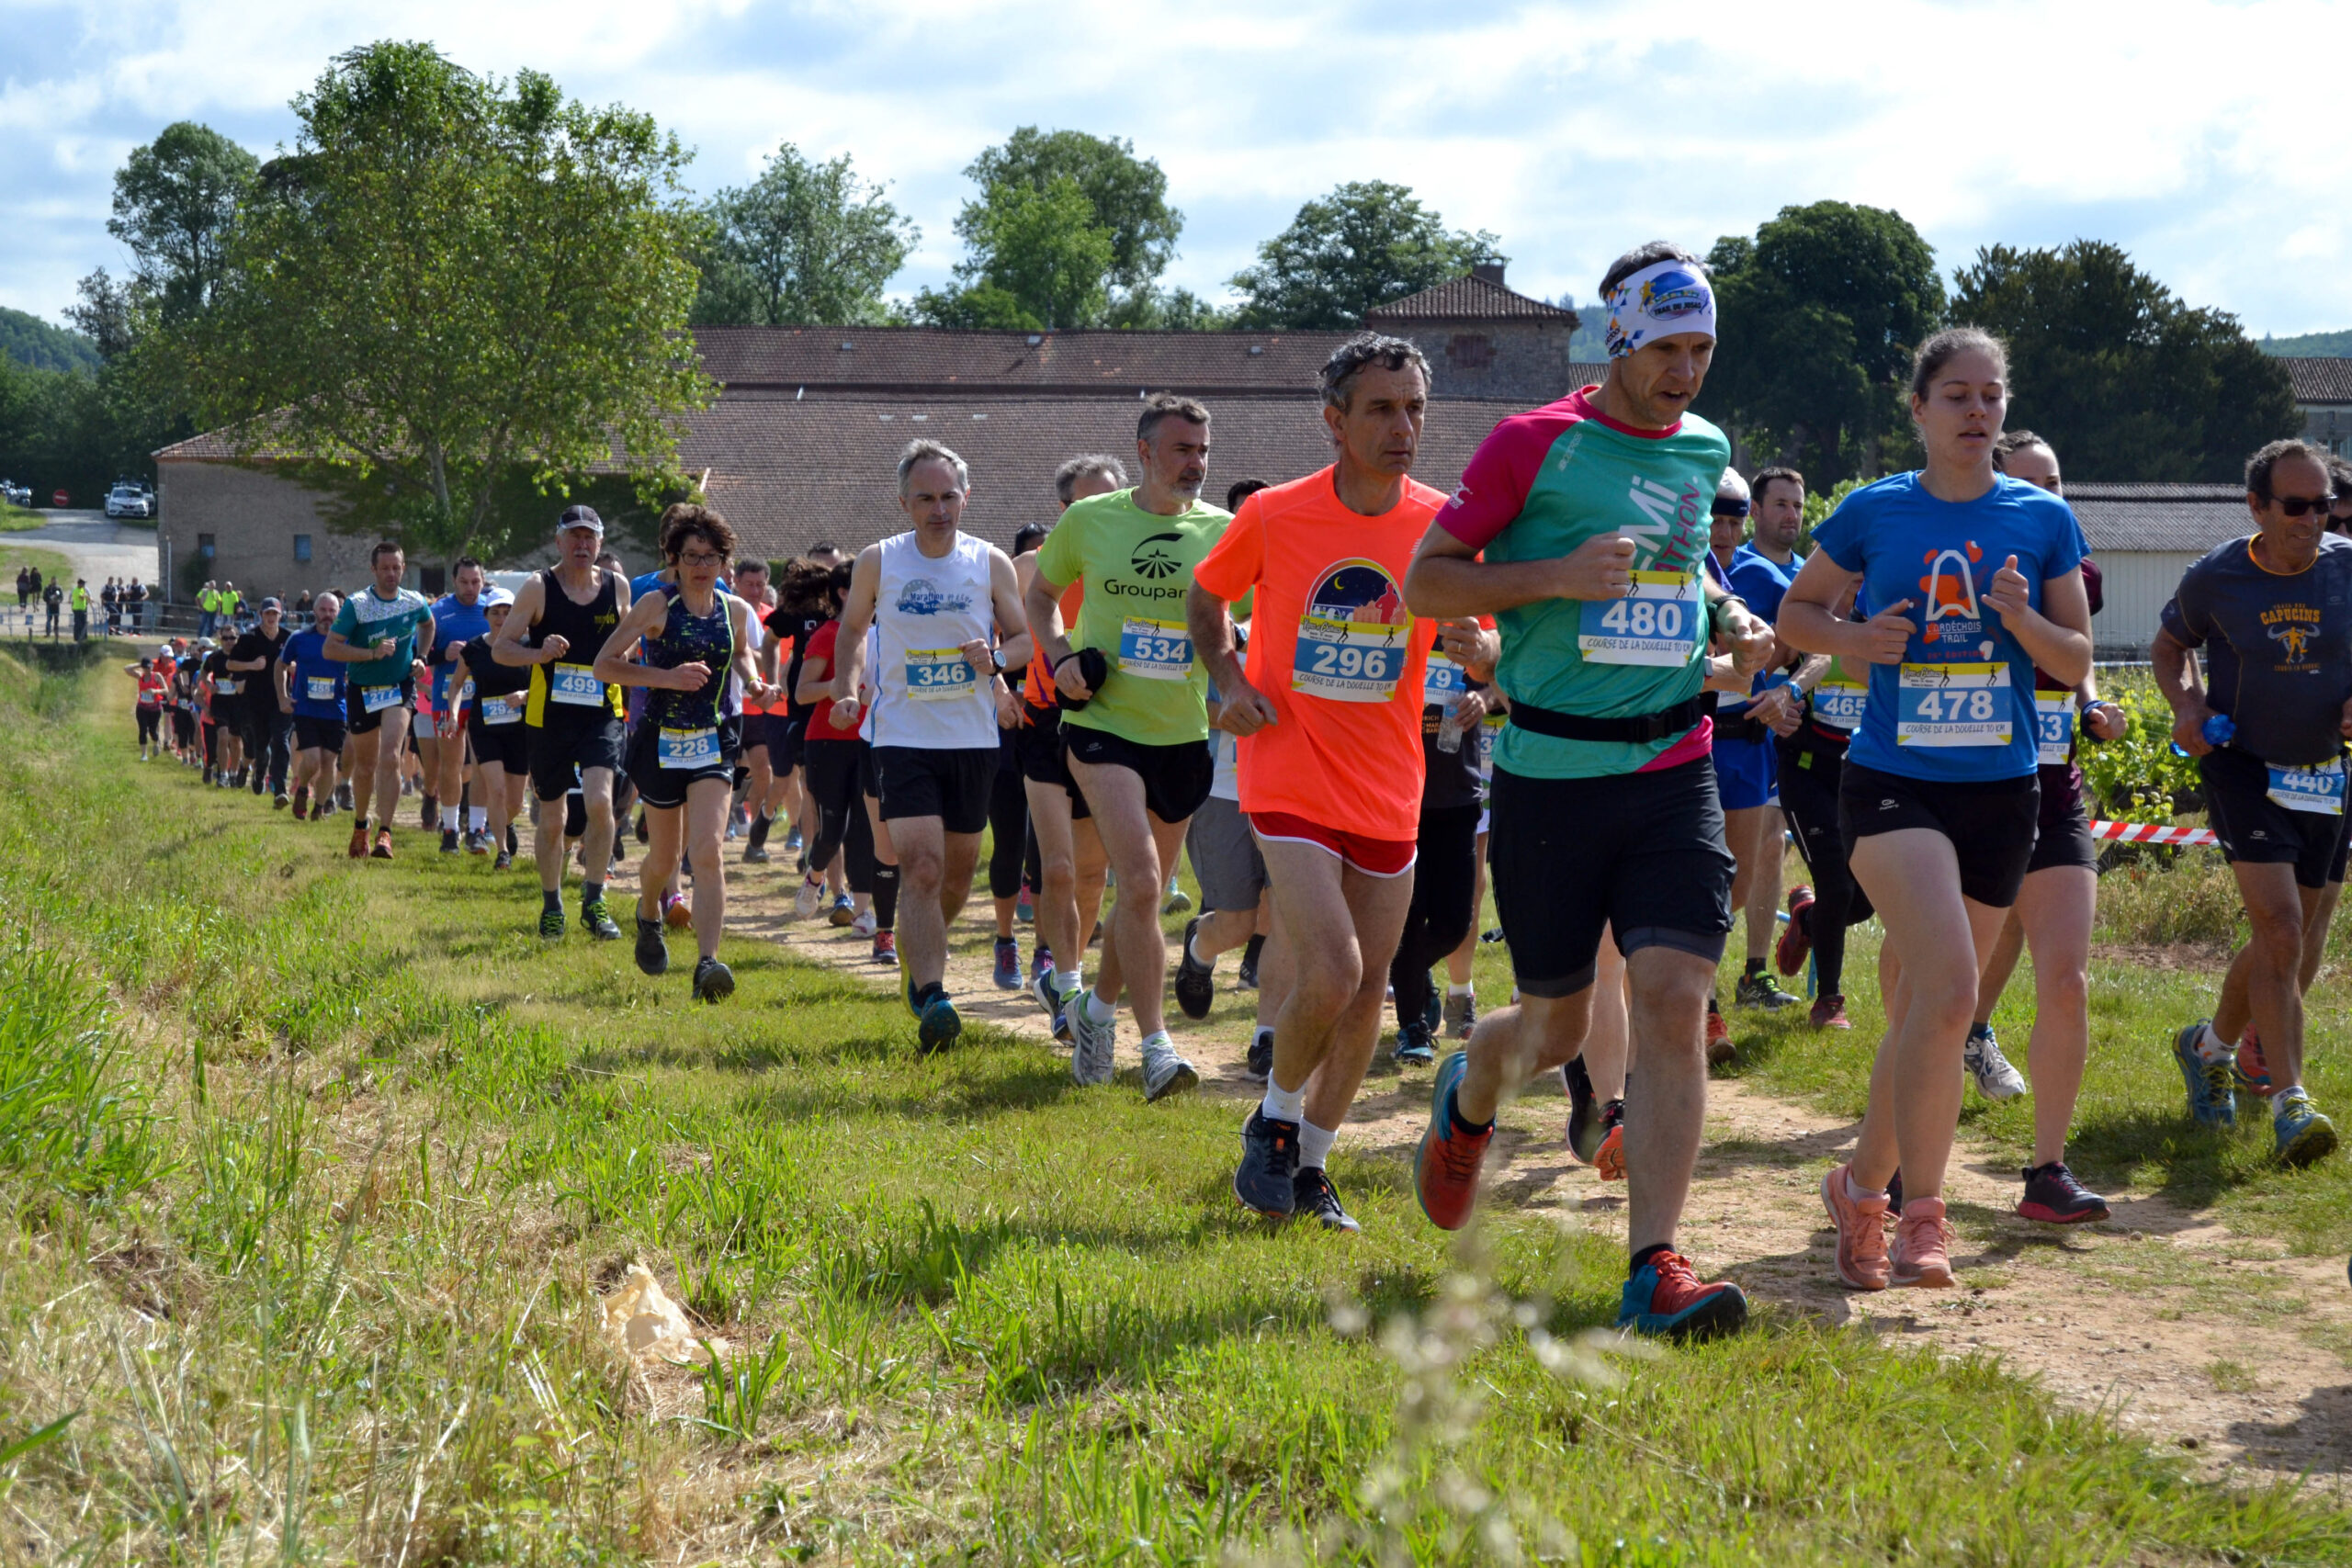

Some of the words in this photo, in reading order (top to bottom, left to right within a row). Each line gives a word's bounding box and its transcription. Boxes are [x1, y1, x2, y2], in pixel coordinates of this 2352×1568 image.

[1601, 600, 1682, 637] 480
[2260, 608, 2320, 625] CAPUCINS
[1587, 637, 1617, 649] COURSE
[1619, 639, 1629, 649] DE
[1631, 640, 1640, 650] LA
[1642, 641, 1672, 651] DOUELLE
[1941, 634, 1968, 643] TRAIL
[1135, 637, 1186, 662] 534
[1312, 645, 1387, 679] 296
[918, 663, 967, 686] 346
[1299, 673, 1323, 686] COURSE
[1326, 679, 1335, 687] DE
[1336, 681, 1345, 689] LA
[1347, 681, 1374, 691] DOUELLE
[561, 676, 597, 694] 499
[1824, 697, 1866, 716] 465
[1917, 690, 1994, 721] 478
[1905, 723, 1931, 734] COURSE
[1934, 724, 1943, 734] DE
[1944, 724, 1953, 734] LA
[1955, 724, 1984, 734] DOUELLE
[1996, 723, 2006, 733] KM
[669, 738, 709, 758] 228
[2282, 773, 2334, 795] 440
